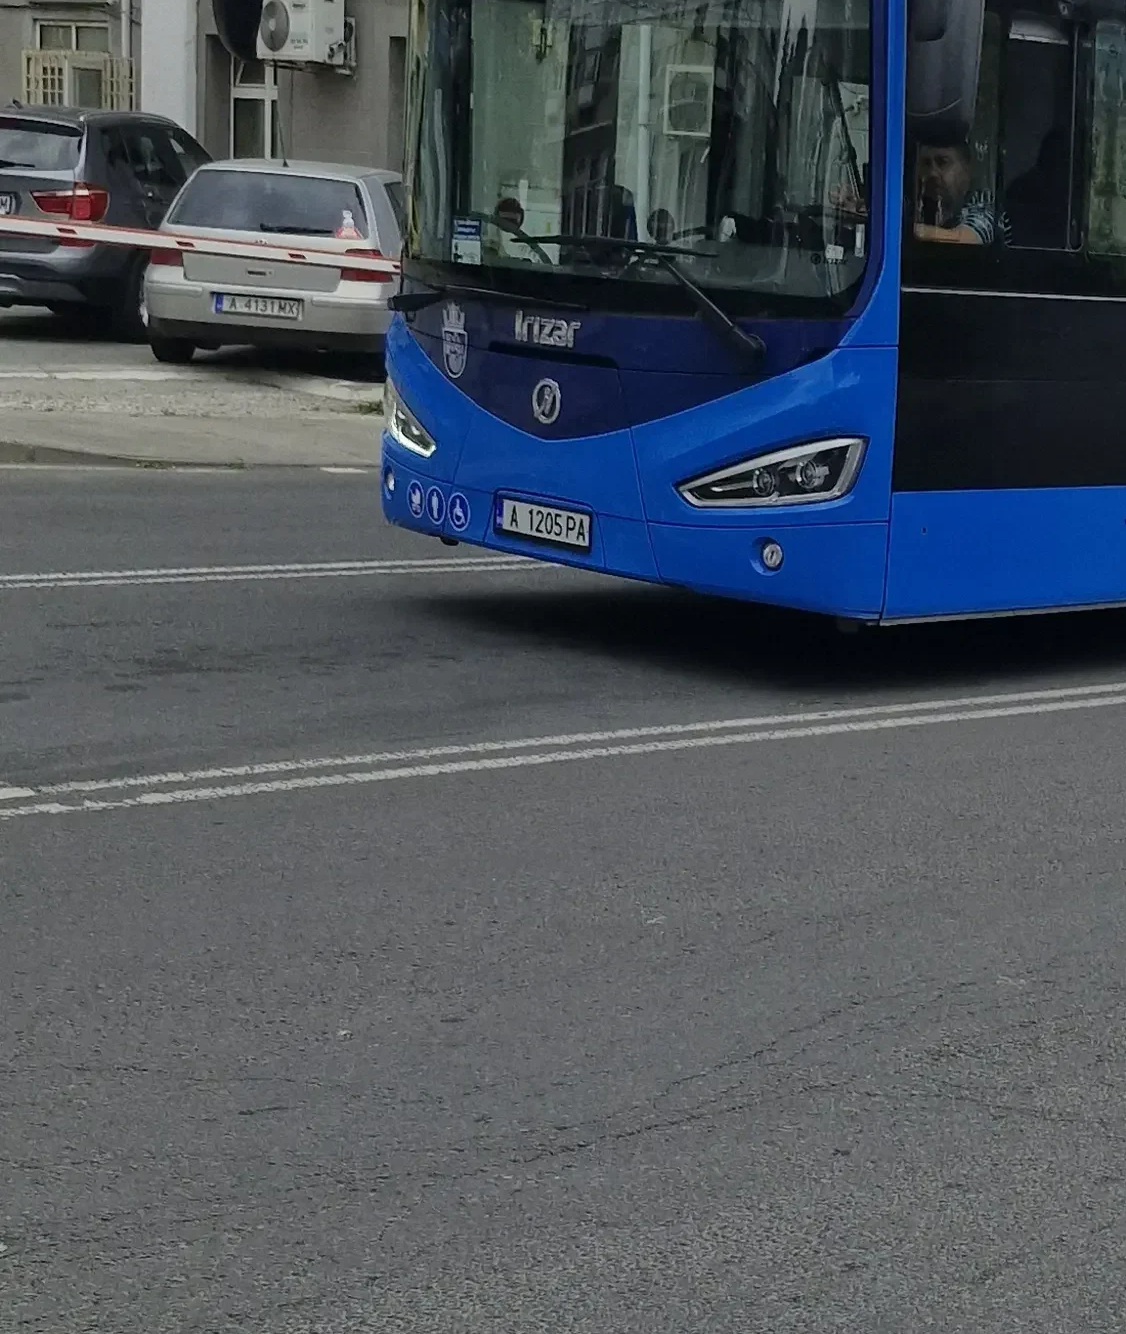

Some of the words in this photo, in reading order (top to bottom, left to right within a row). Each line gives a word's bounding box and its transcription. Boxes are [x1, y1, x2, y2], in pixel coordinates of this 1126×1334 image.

[228, 297, 238, 310] A
[515, 310, 581, 348] Irizar
[510, 505, 519, 528] A
